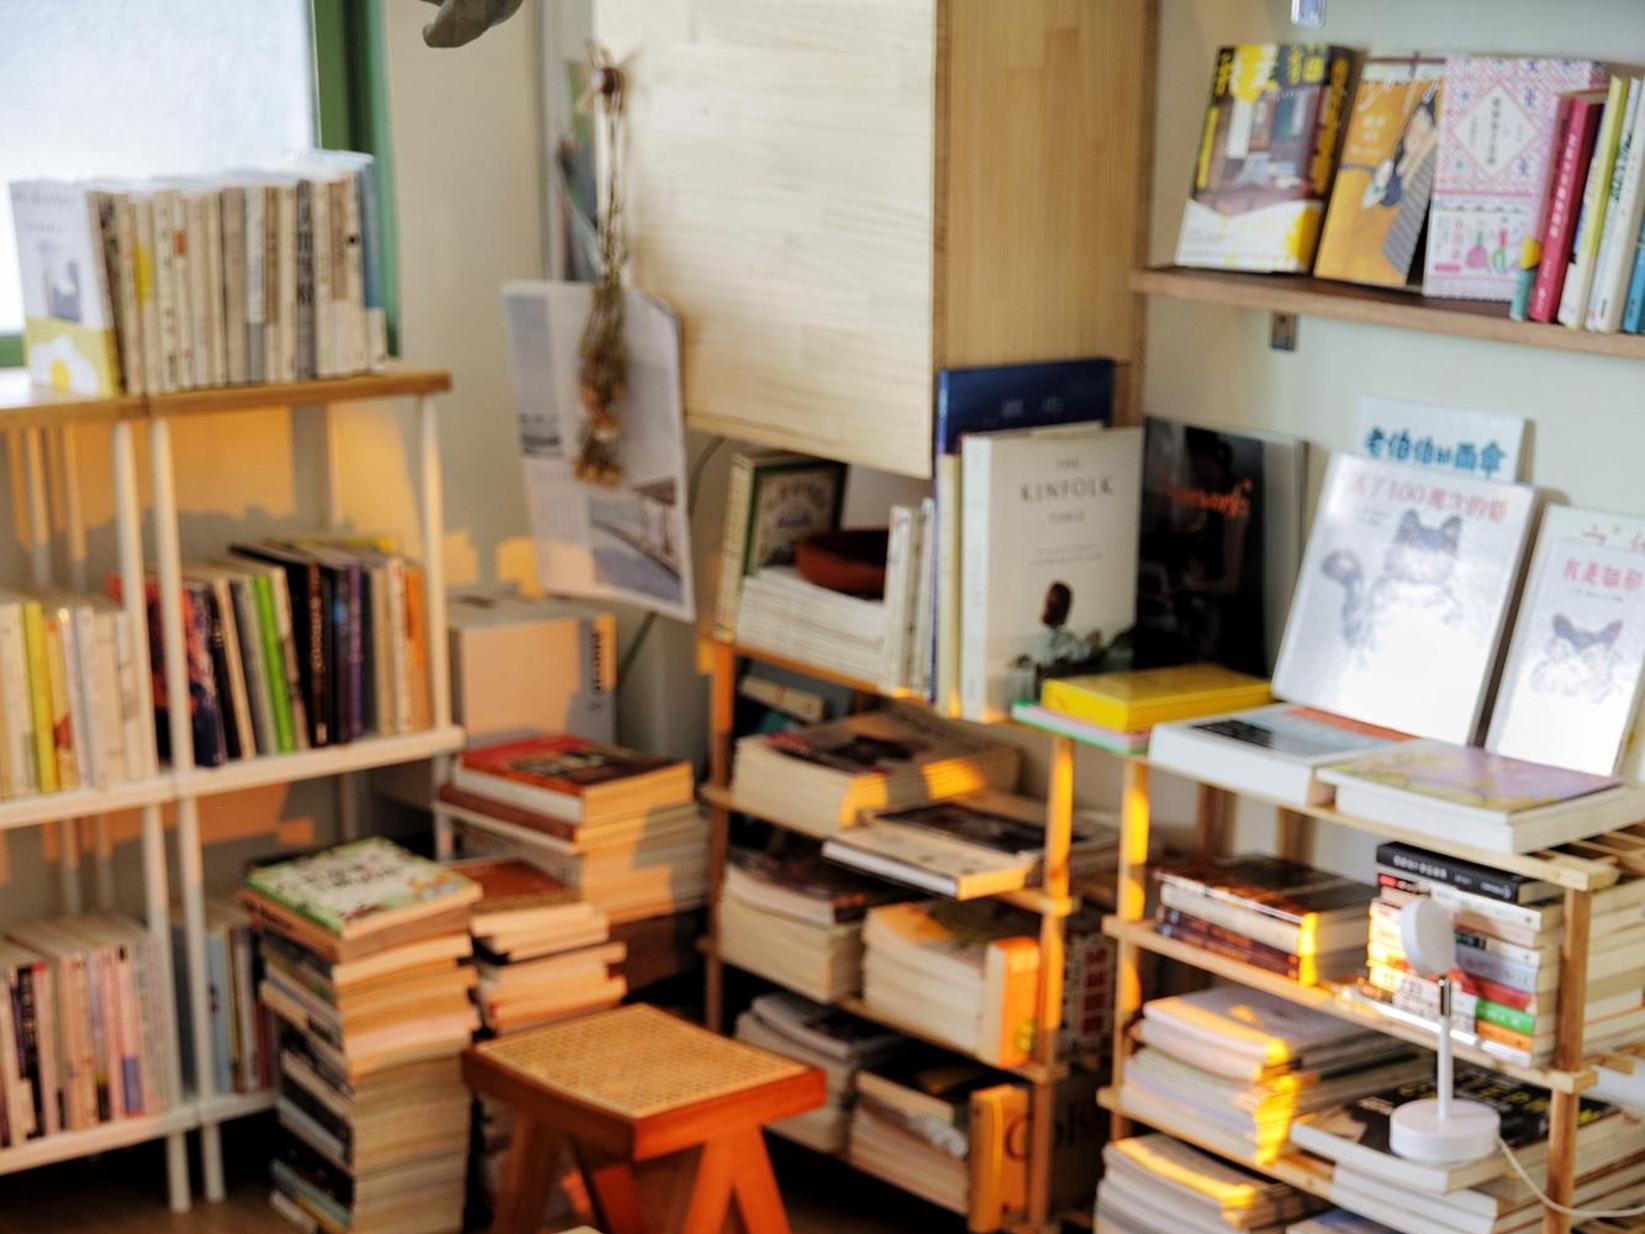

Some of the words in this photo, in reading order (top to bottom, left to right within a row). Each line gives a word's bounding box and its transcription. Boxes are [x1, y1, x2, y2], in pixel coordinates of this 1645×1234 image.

[1365, 426, 1506, 479] 老伯伯的雨傘
[1019, 477, 1115, 502] KINFOLK
